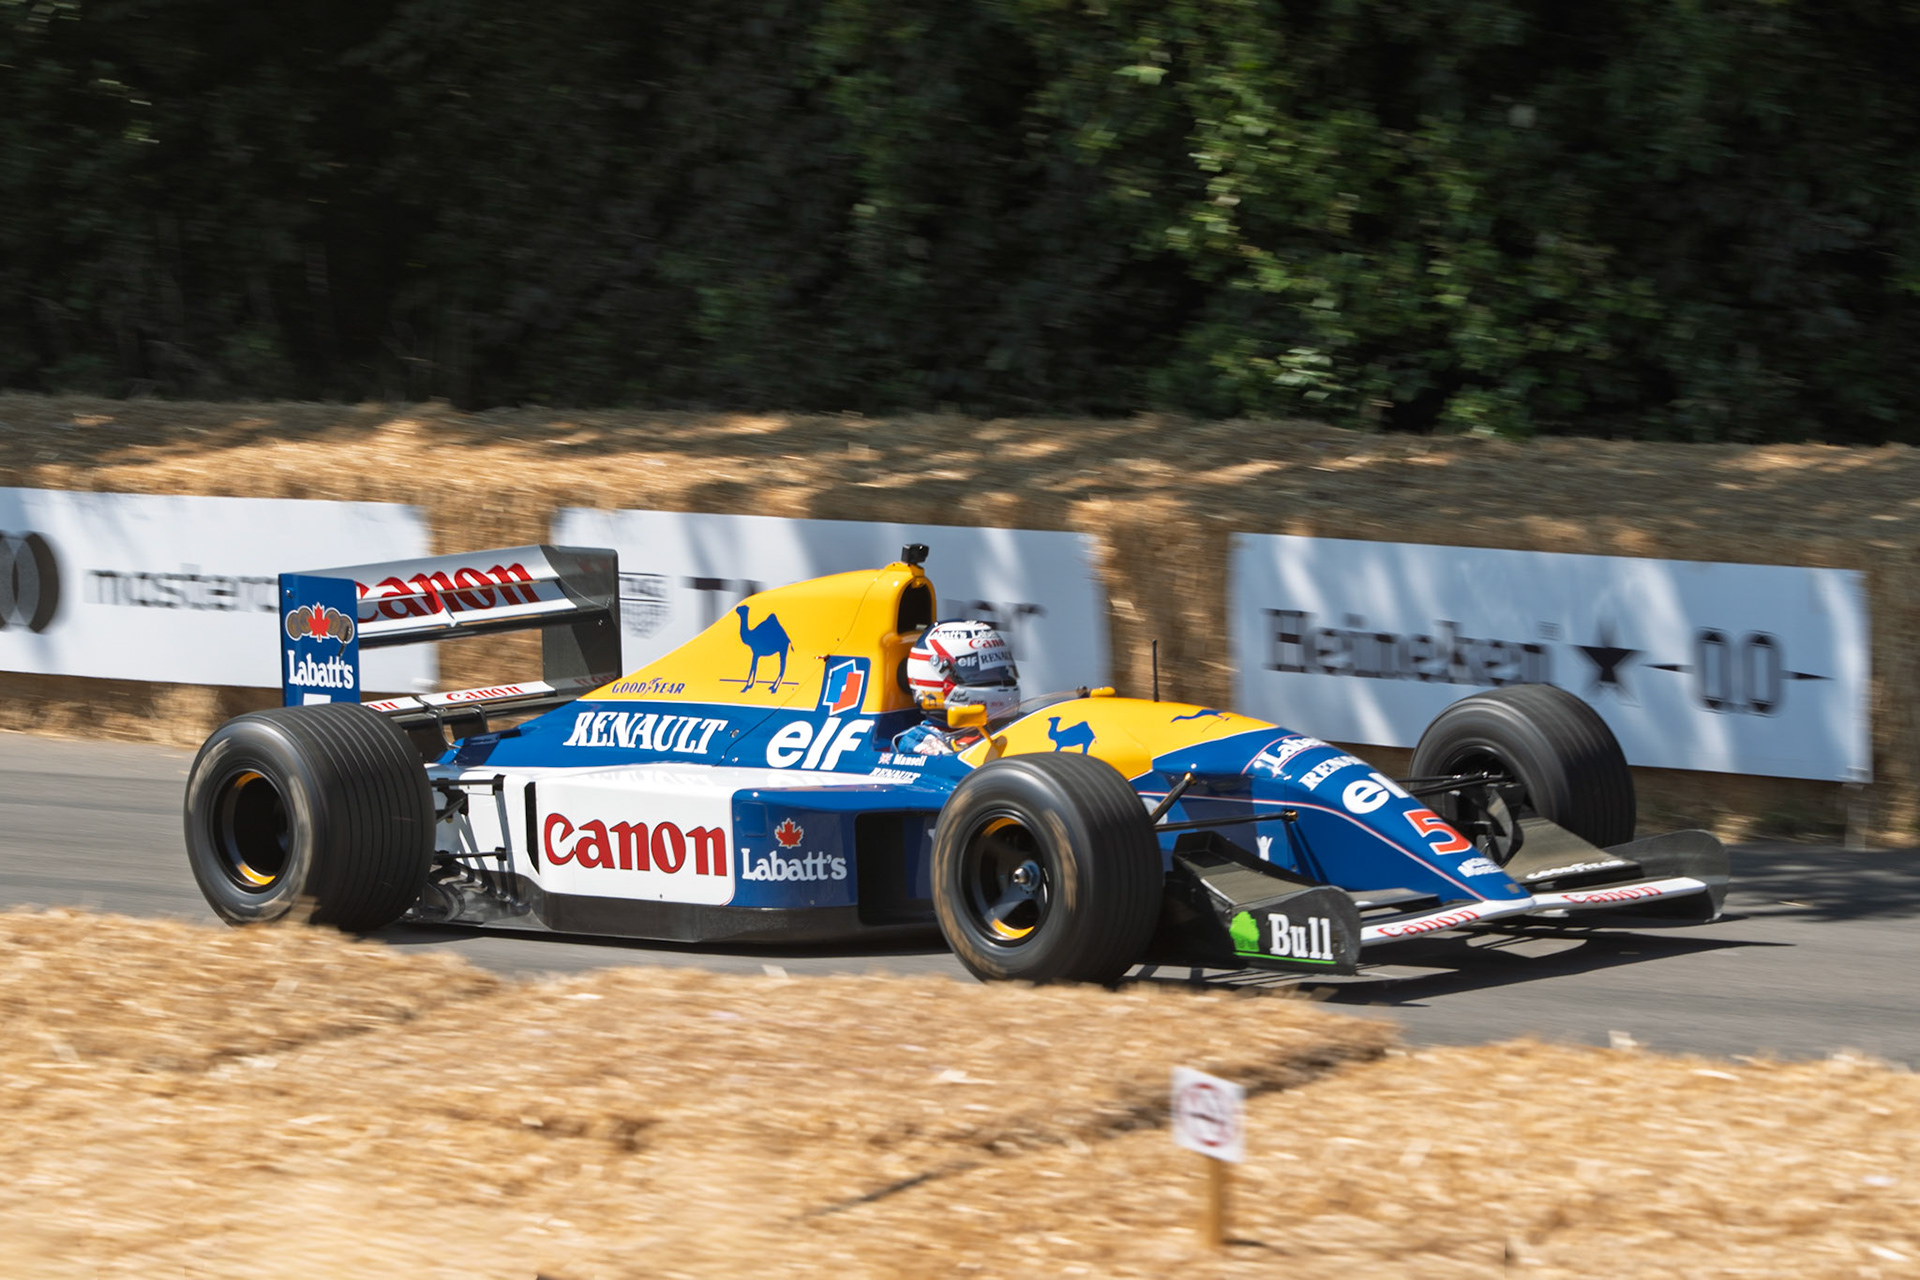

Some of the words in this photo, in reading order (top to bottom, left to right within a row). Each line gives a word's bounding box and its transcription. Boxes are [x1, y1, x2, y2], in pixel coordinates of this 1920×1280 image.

[287, 649, 354, 689] Labatt's
[957, 657, 978, 667] elf
[446, 685, 526, 702] Canon
[563, 711, 729, 754] RENAULT
[766, 717, 875, 771] elf
[869, 767, 922, 784] RENAULT
[893, 754, 928, 767] Mansell
[1342, 772, 1412, 814] el
[544, 812, 728, 877] Canon
[1402, 808, 1473, 856] 5
[741, 847, 847, 882] Labatt's
[1561, 886, 1663, 904] Canon
[1268, 913, 1334, 960] Bull
[1377, 910, 1481, 938] Canon
